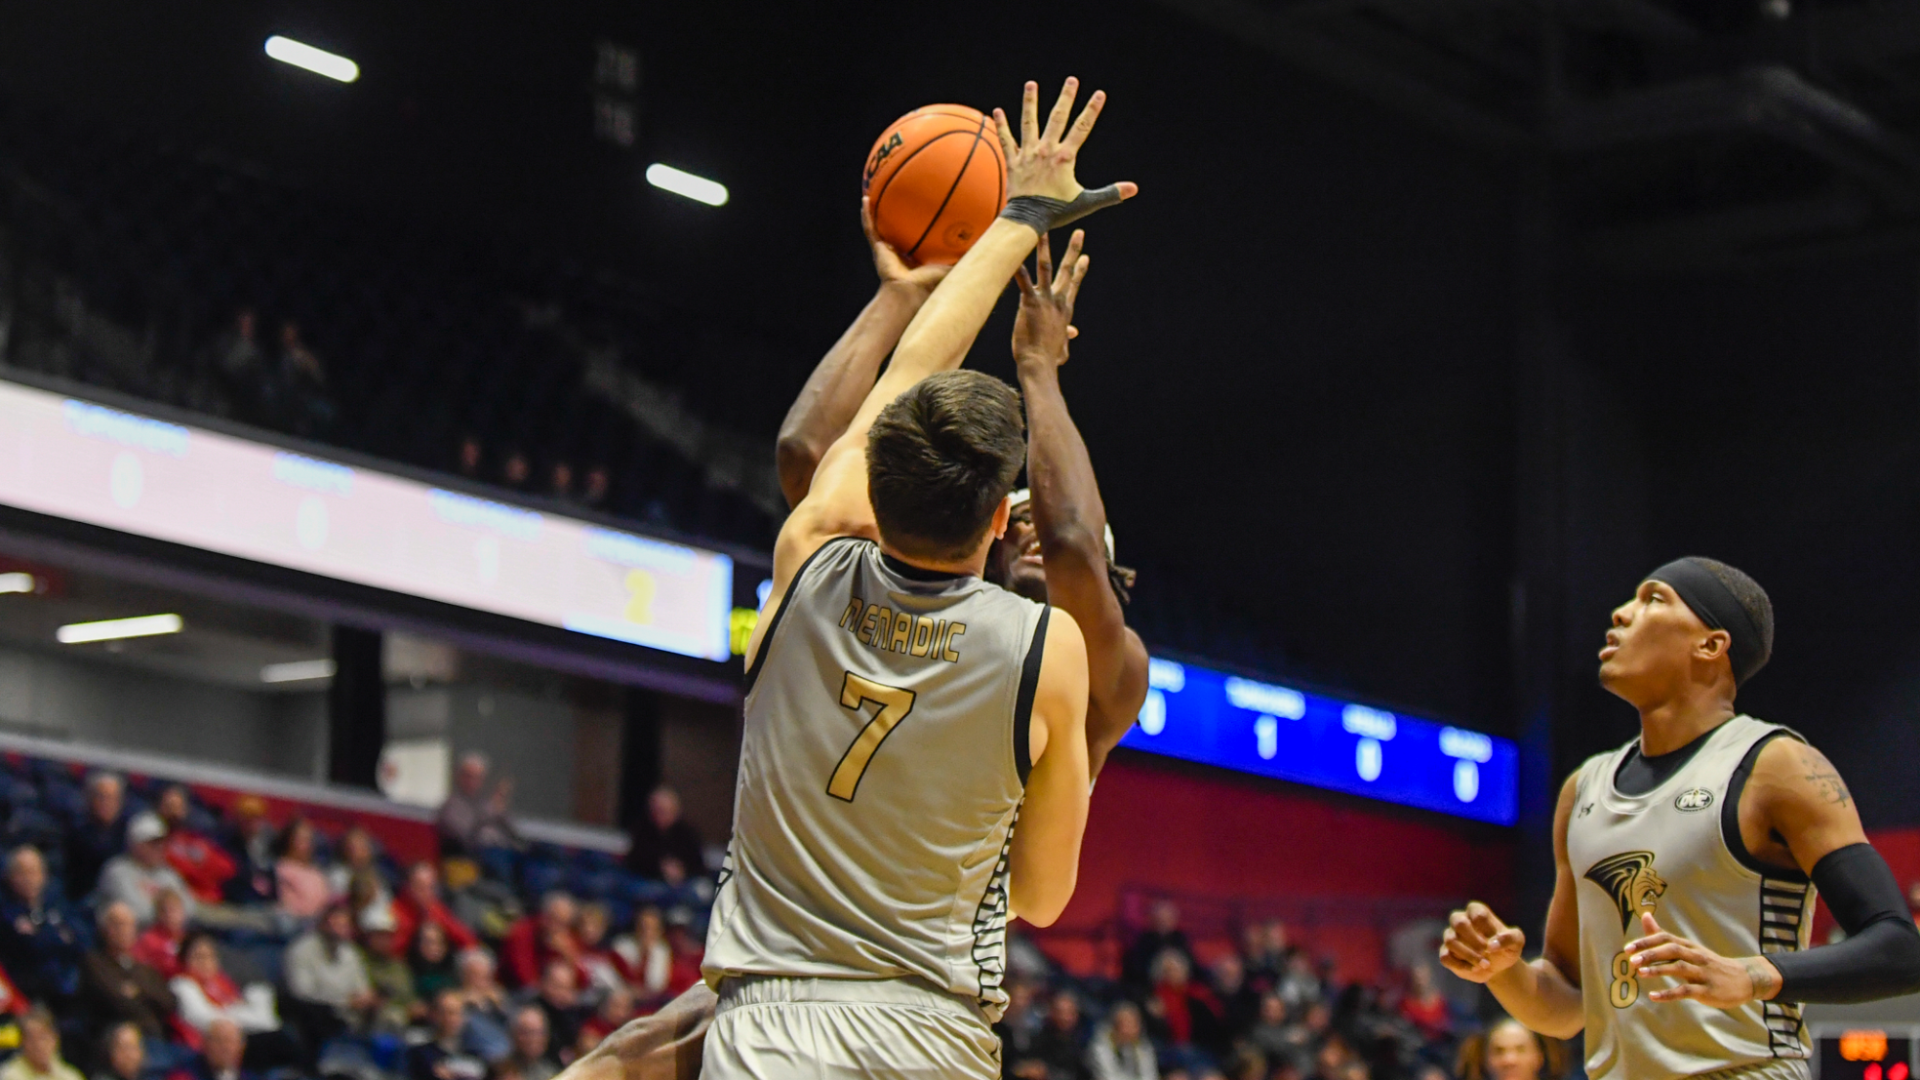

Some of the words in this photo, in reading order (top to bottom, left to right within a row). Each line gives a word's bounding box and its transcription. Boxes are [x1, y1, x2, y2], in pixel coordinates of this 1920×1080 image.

[839, 597, 966, 663] NENADIC
[826, 670, 917, 803] 7
[1610, 950, 1639, 1009] 8
